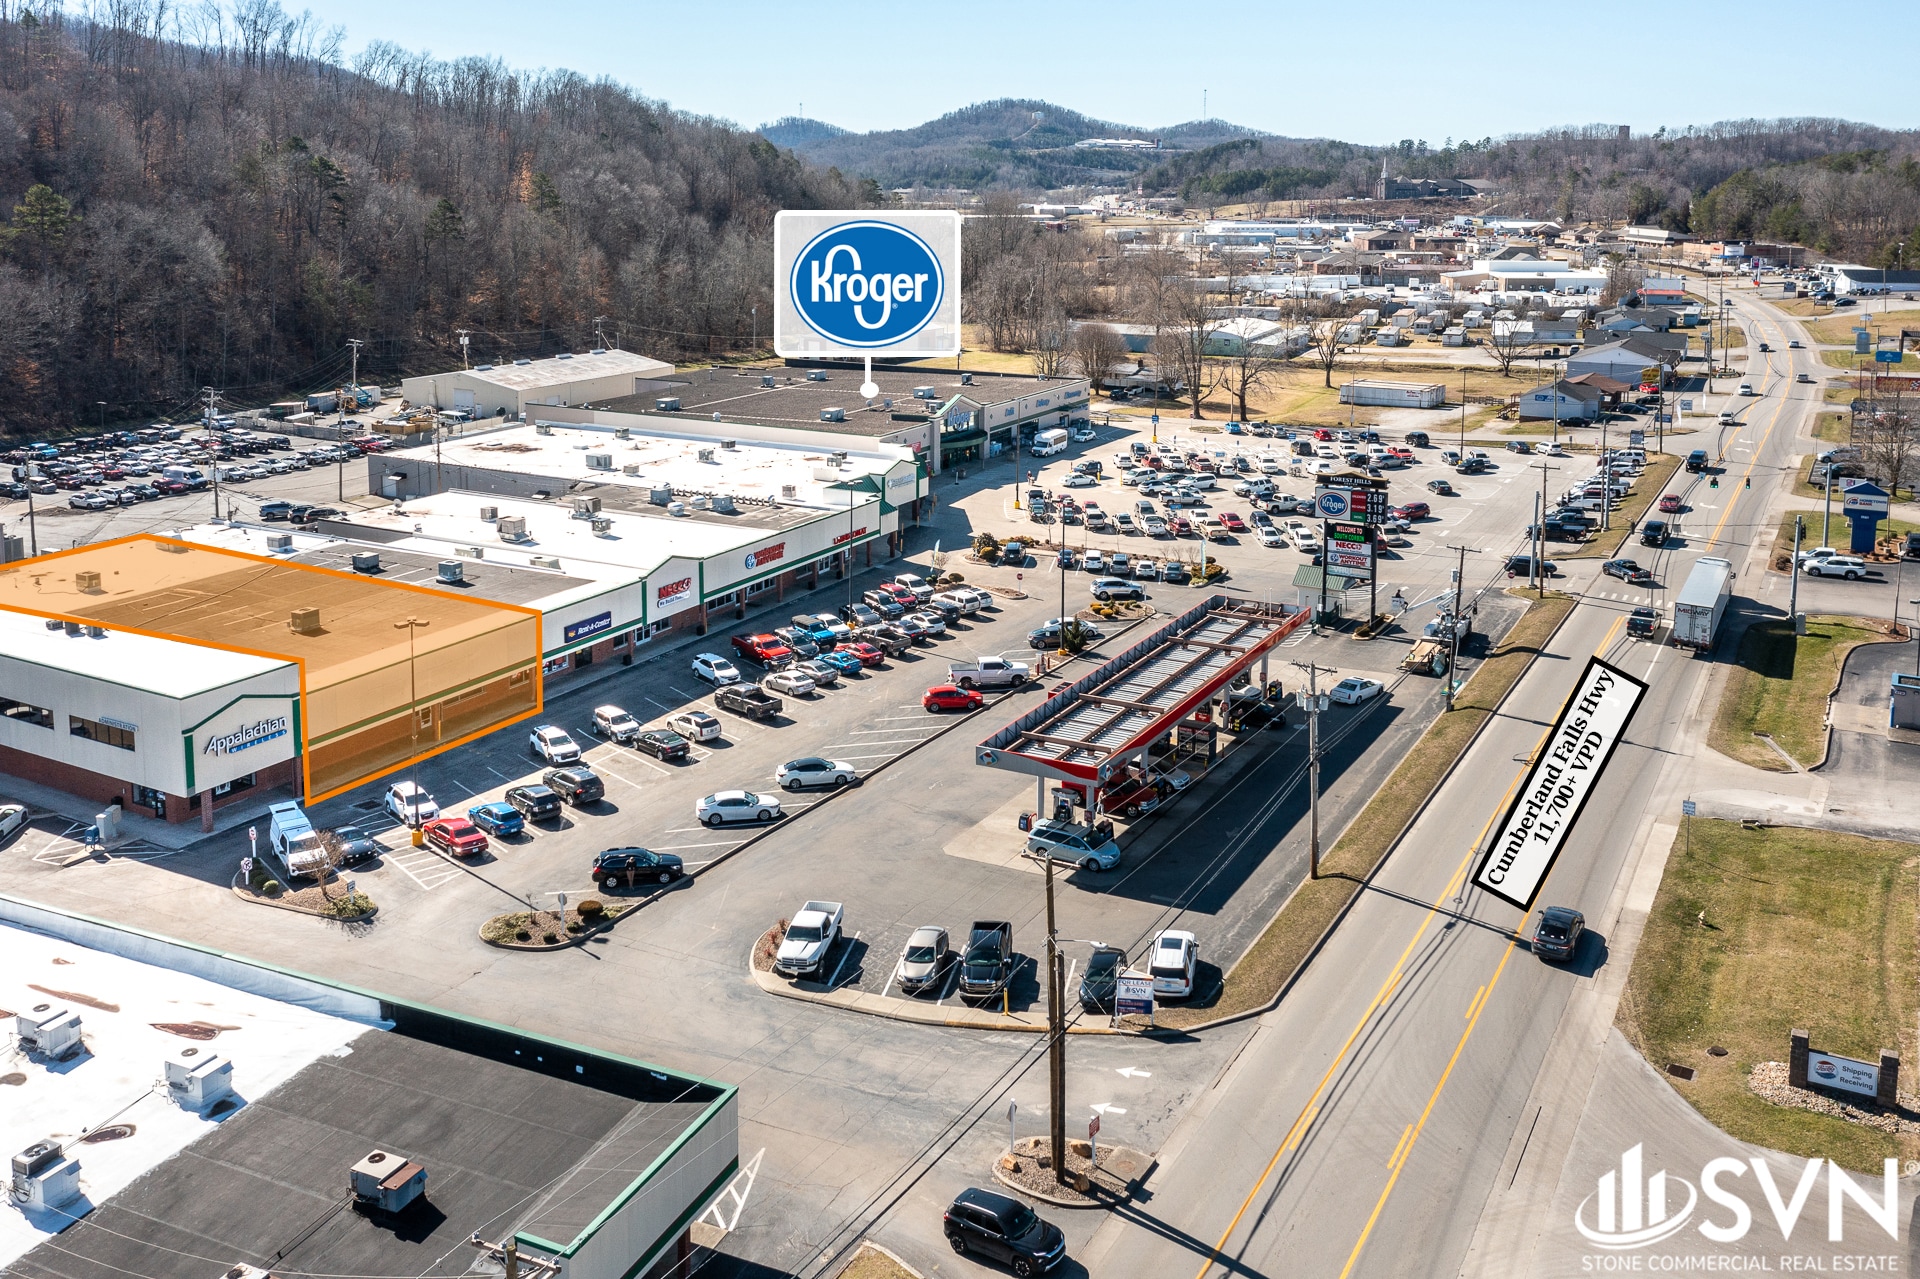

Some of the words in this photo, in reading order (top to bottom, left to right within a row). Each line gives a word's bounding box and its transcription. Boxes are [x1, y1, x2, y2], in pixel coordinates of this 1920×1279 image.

[1322, 496, 1345, 512] Kroger
[1334, 532, 1348, 540] SOUTH
[1336, 525, 1356, 534] WELCOME
[1339, 554, 1367, 562] WORKOUT
[577, 617, 611, 635] Rent-A-Center
[203, 716, 287, 757] Appalachian
[231, 730, 287, 753] WIRELESS
[1841, 1065, 1873, 1080] Shipping
[1839, 1076, 1874, 1091] Receiving
